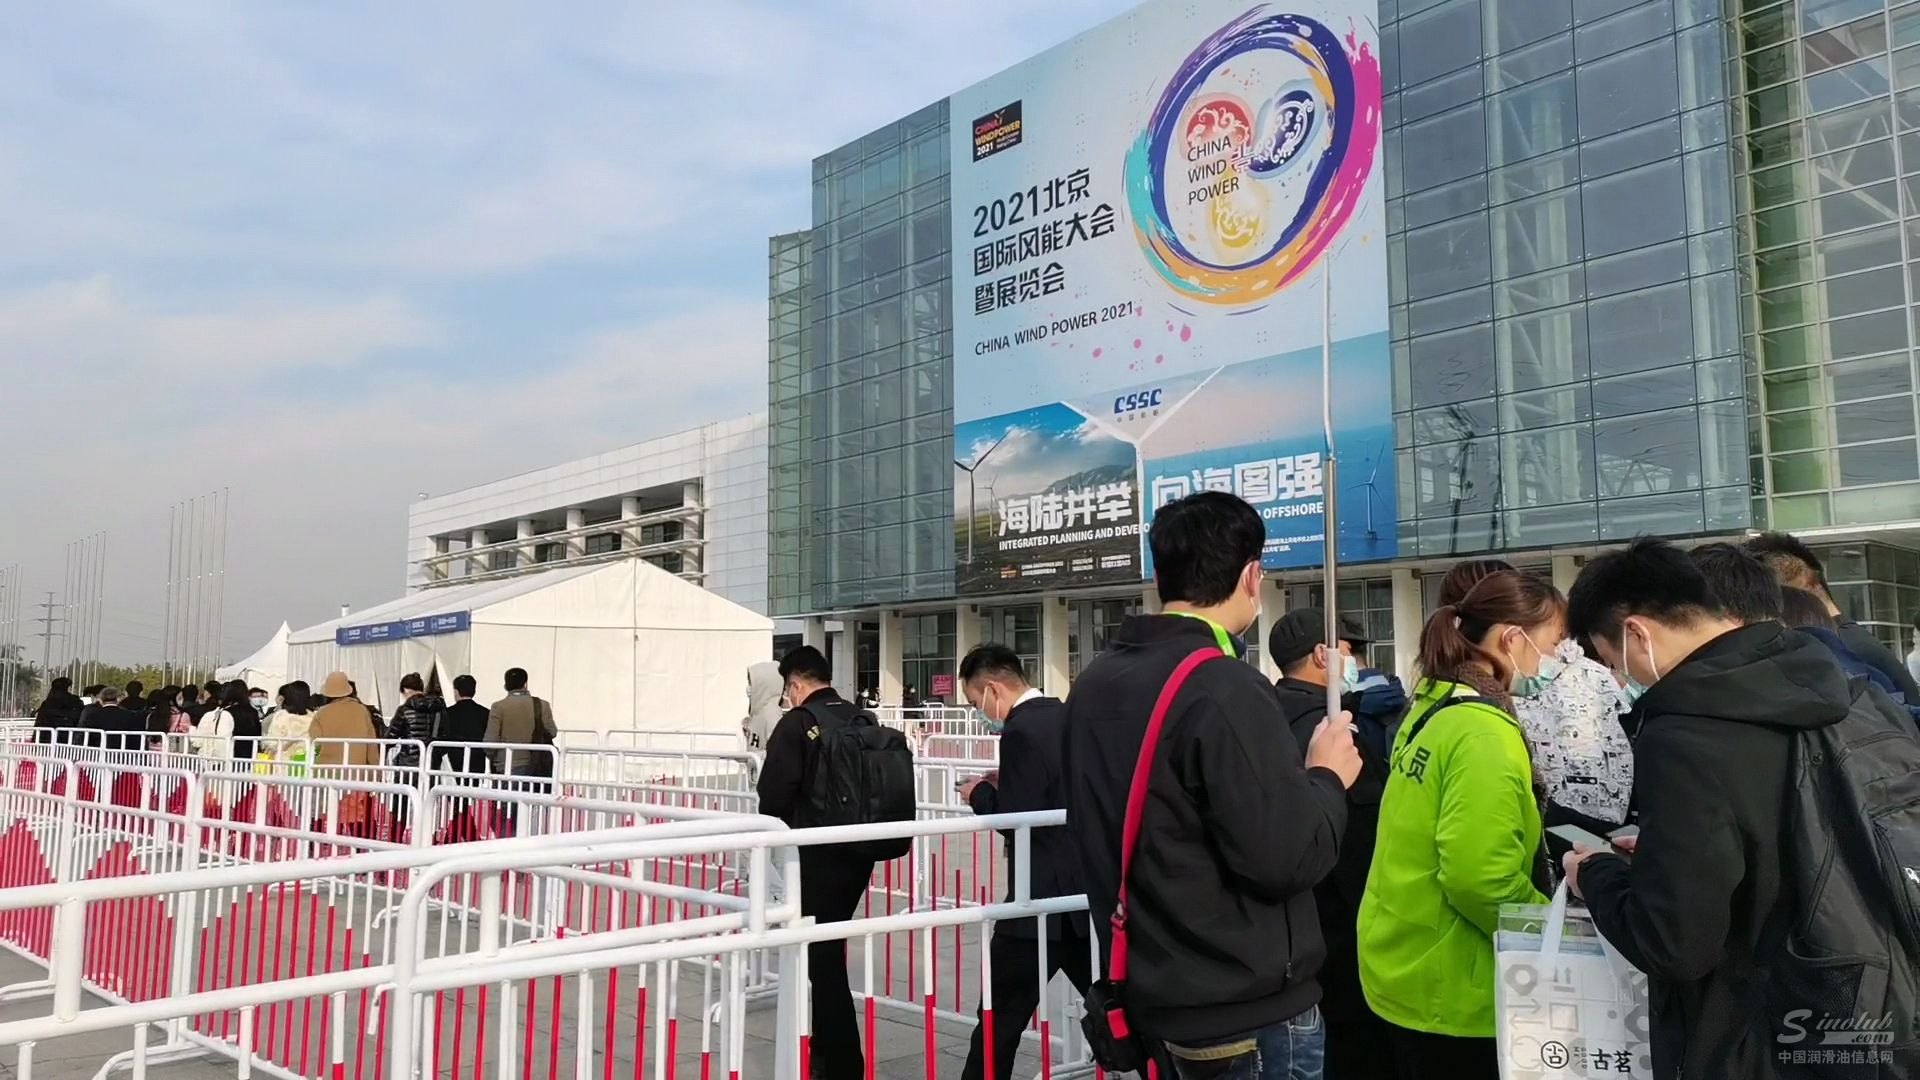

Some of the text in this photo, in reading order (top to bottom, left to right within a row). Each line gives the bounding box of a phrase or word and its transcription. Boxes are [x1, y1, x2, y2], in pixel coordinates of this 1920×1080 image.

[976, 142, 993, 156] 2021
[1187, 135, 1231, 161] CHINA
[1188, 159, 1227, 184] WIND
[1188, 176, 1240, 205] POWER
[973, 167, 1090, 238] 2021北京
[973, 203, 1115, 277] 国际风能大会
[974, 261, 1065, 316] 暨展览会
[975, 301, 1133, 356] CHINA WIND POWER 2021
[1114, 388, 1162, 414] CSSC
[998, 481, 1133, 537] 海陆并举
[999, 535, 1049, 551] INTEGRATED
[1050, 529, 1094, 545] PLANNING
[1095, 526, 1113, 539] AND
[1263, 502, 1324, 519] OFFSHORE
[1589, 1047, 1633, 1073] 古茗
